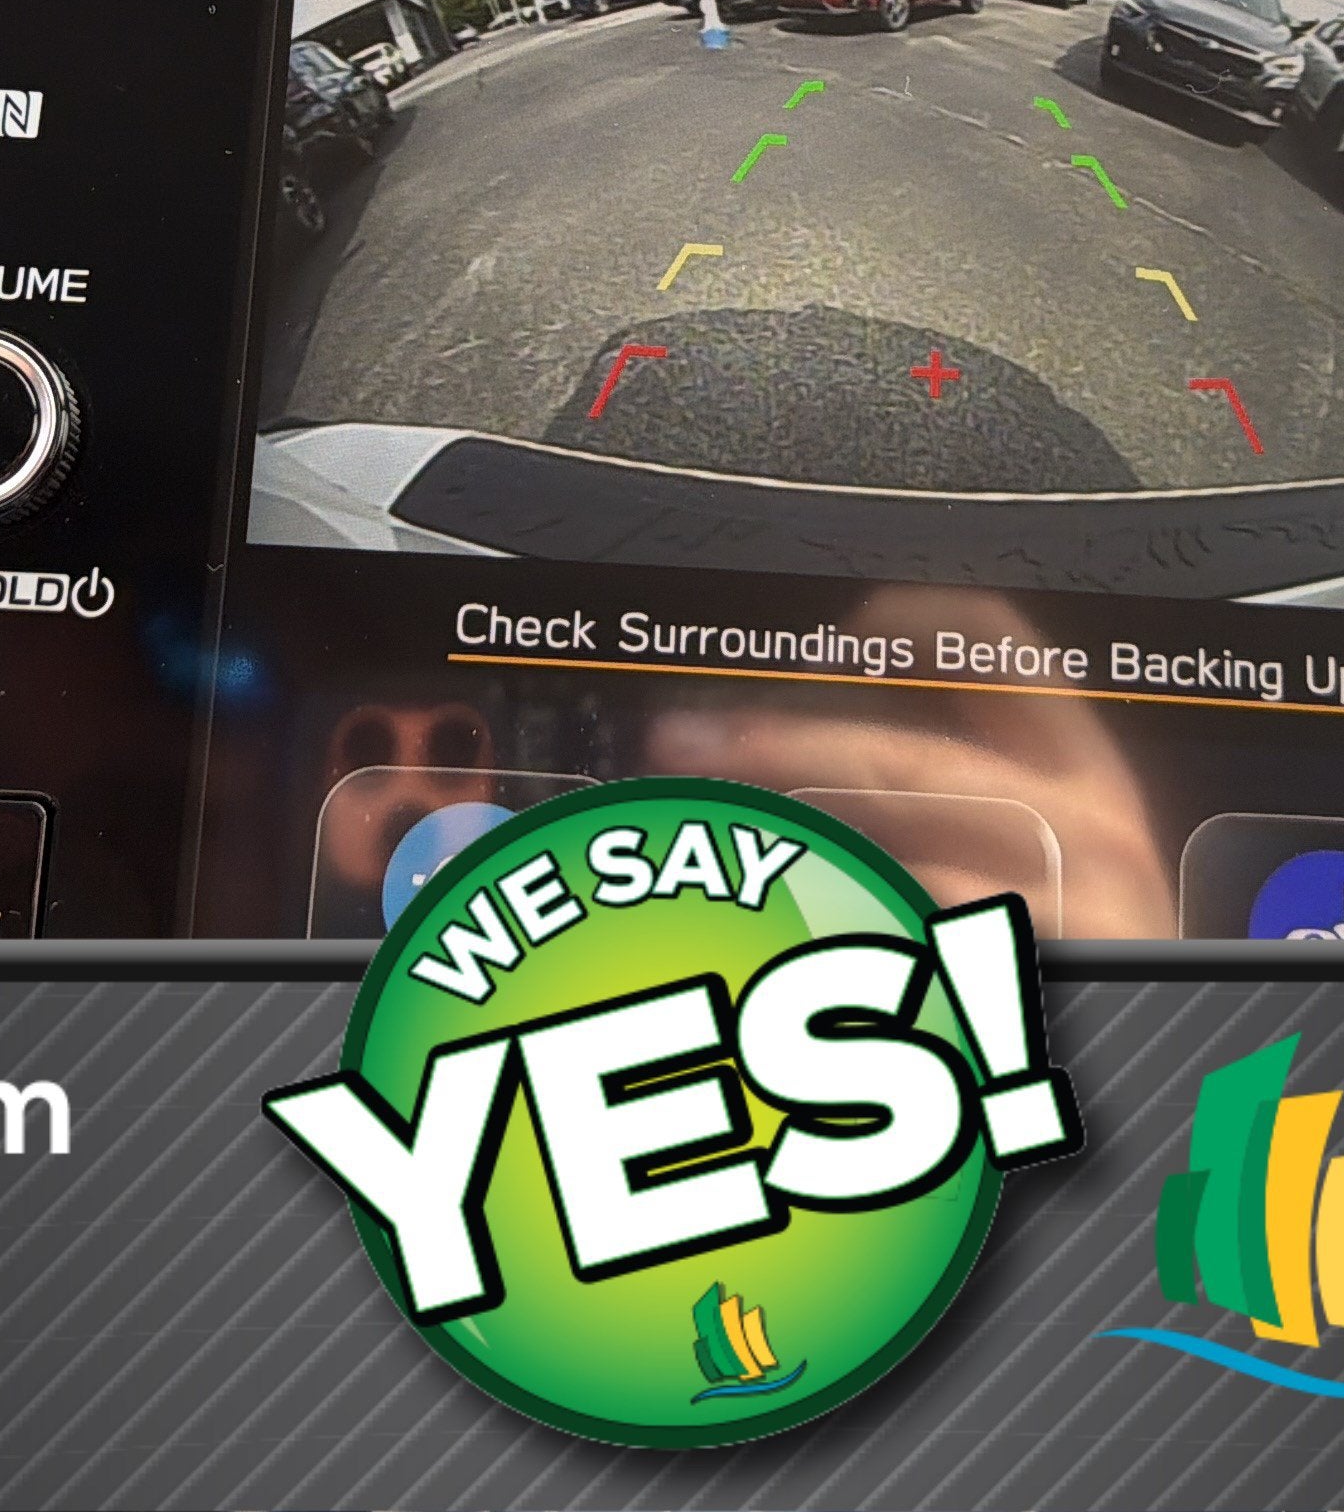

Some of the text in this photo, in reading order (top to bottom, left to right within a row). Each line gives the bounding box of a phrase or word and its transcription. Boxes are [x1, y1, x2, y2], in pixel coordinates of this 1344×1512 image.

[455, 602, 596, 651] Check
[617, 612, 917, 672] Surroundings
[935, 630, 1089, 680] Before
[1111, 642, 1284, 703] Backing
